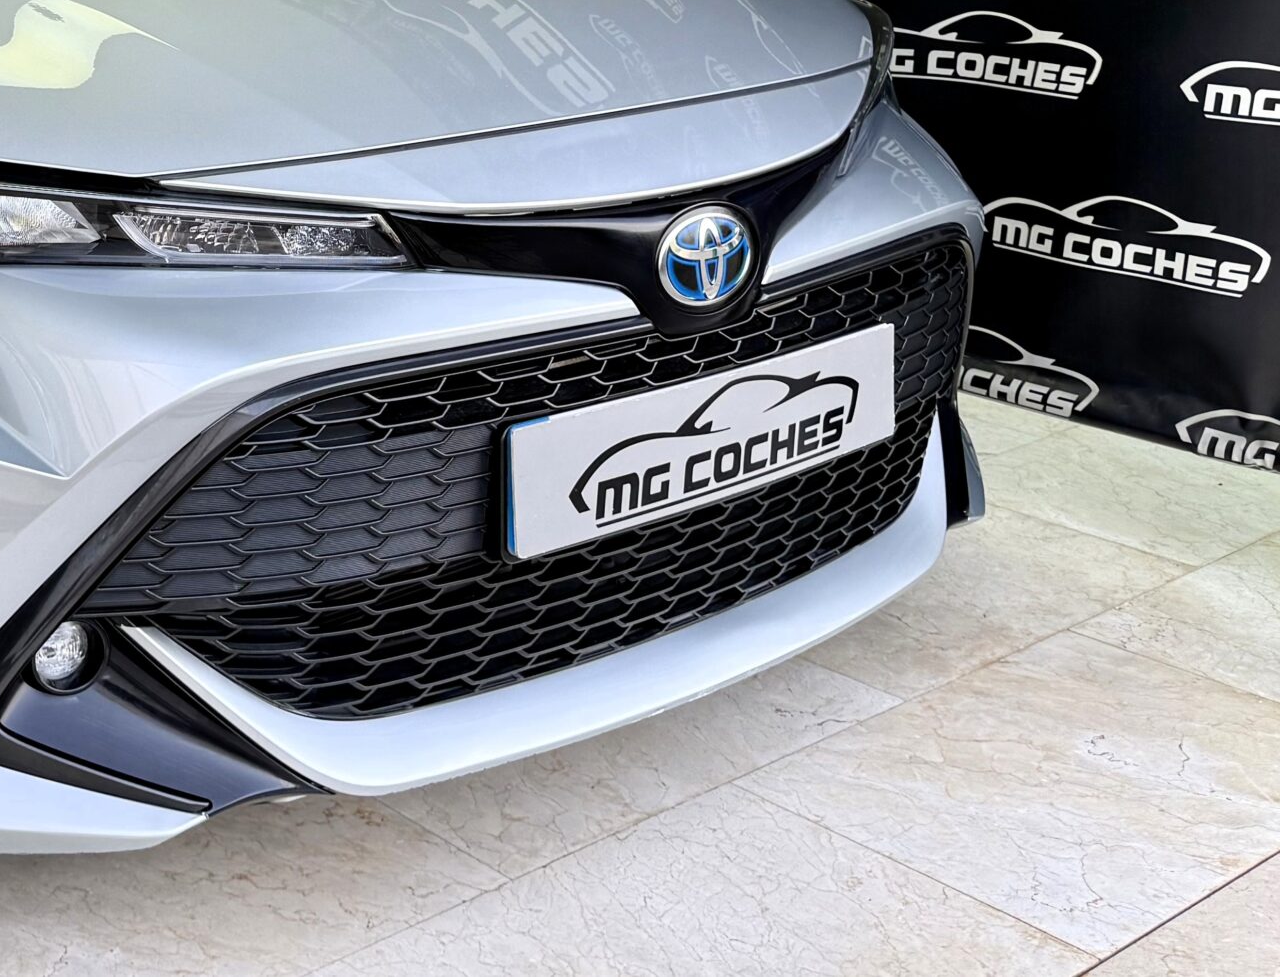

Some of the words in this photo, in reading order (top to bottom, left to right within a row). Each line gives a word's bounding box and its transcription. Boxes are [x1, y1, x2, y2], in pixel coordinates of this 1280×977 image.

[891, 48, 914, 73] G
[927, 50, 1092, 95] COCHES
[992, 215, 1056, 252] MG
[1063, 234, 1253, 292] COCHES
[957, 365, 1079, 418] CHES
[596, 461, 671, 521] MG
[683, 406, 845, 494] COCHES
